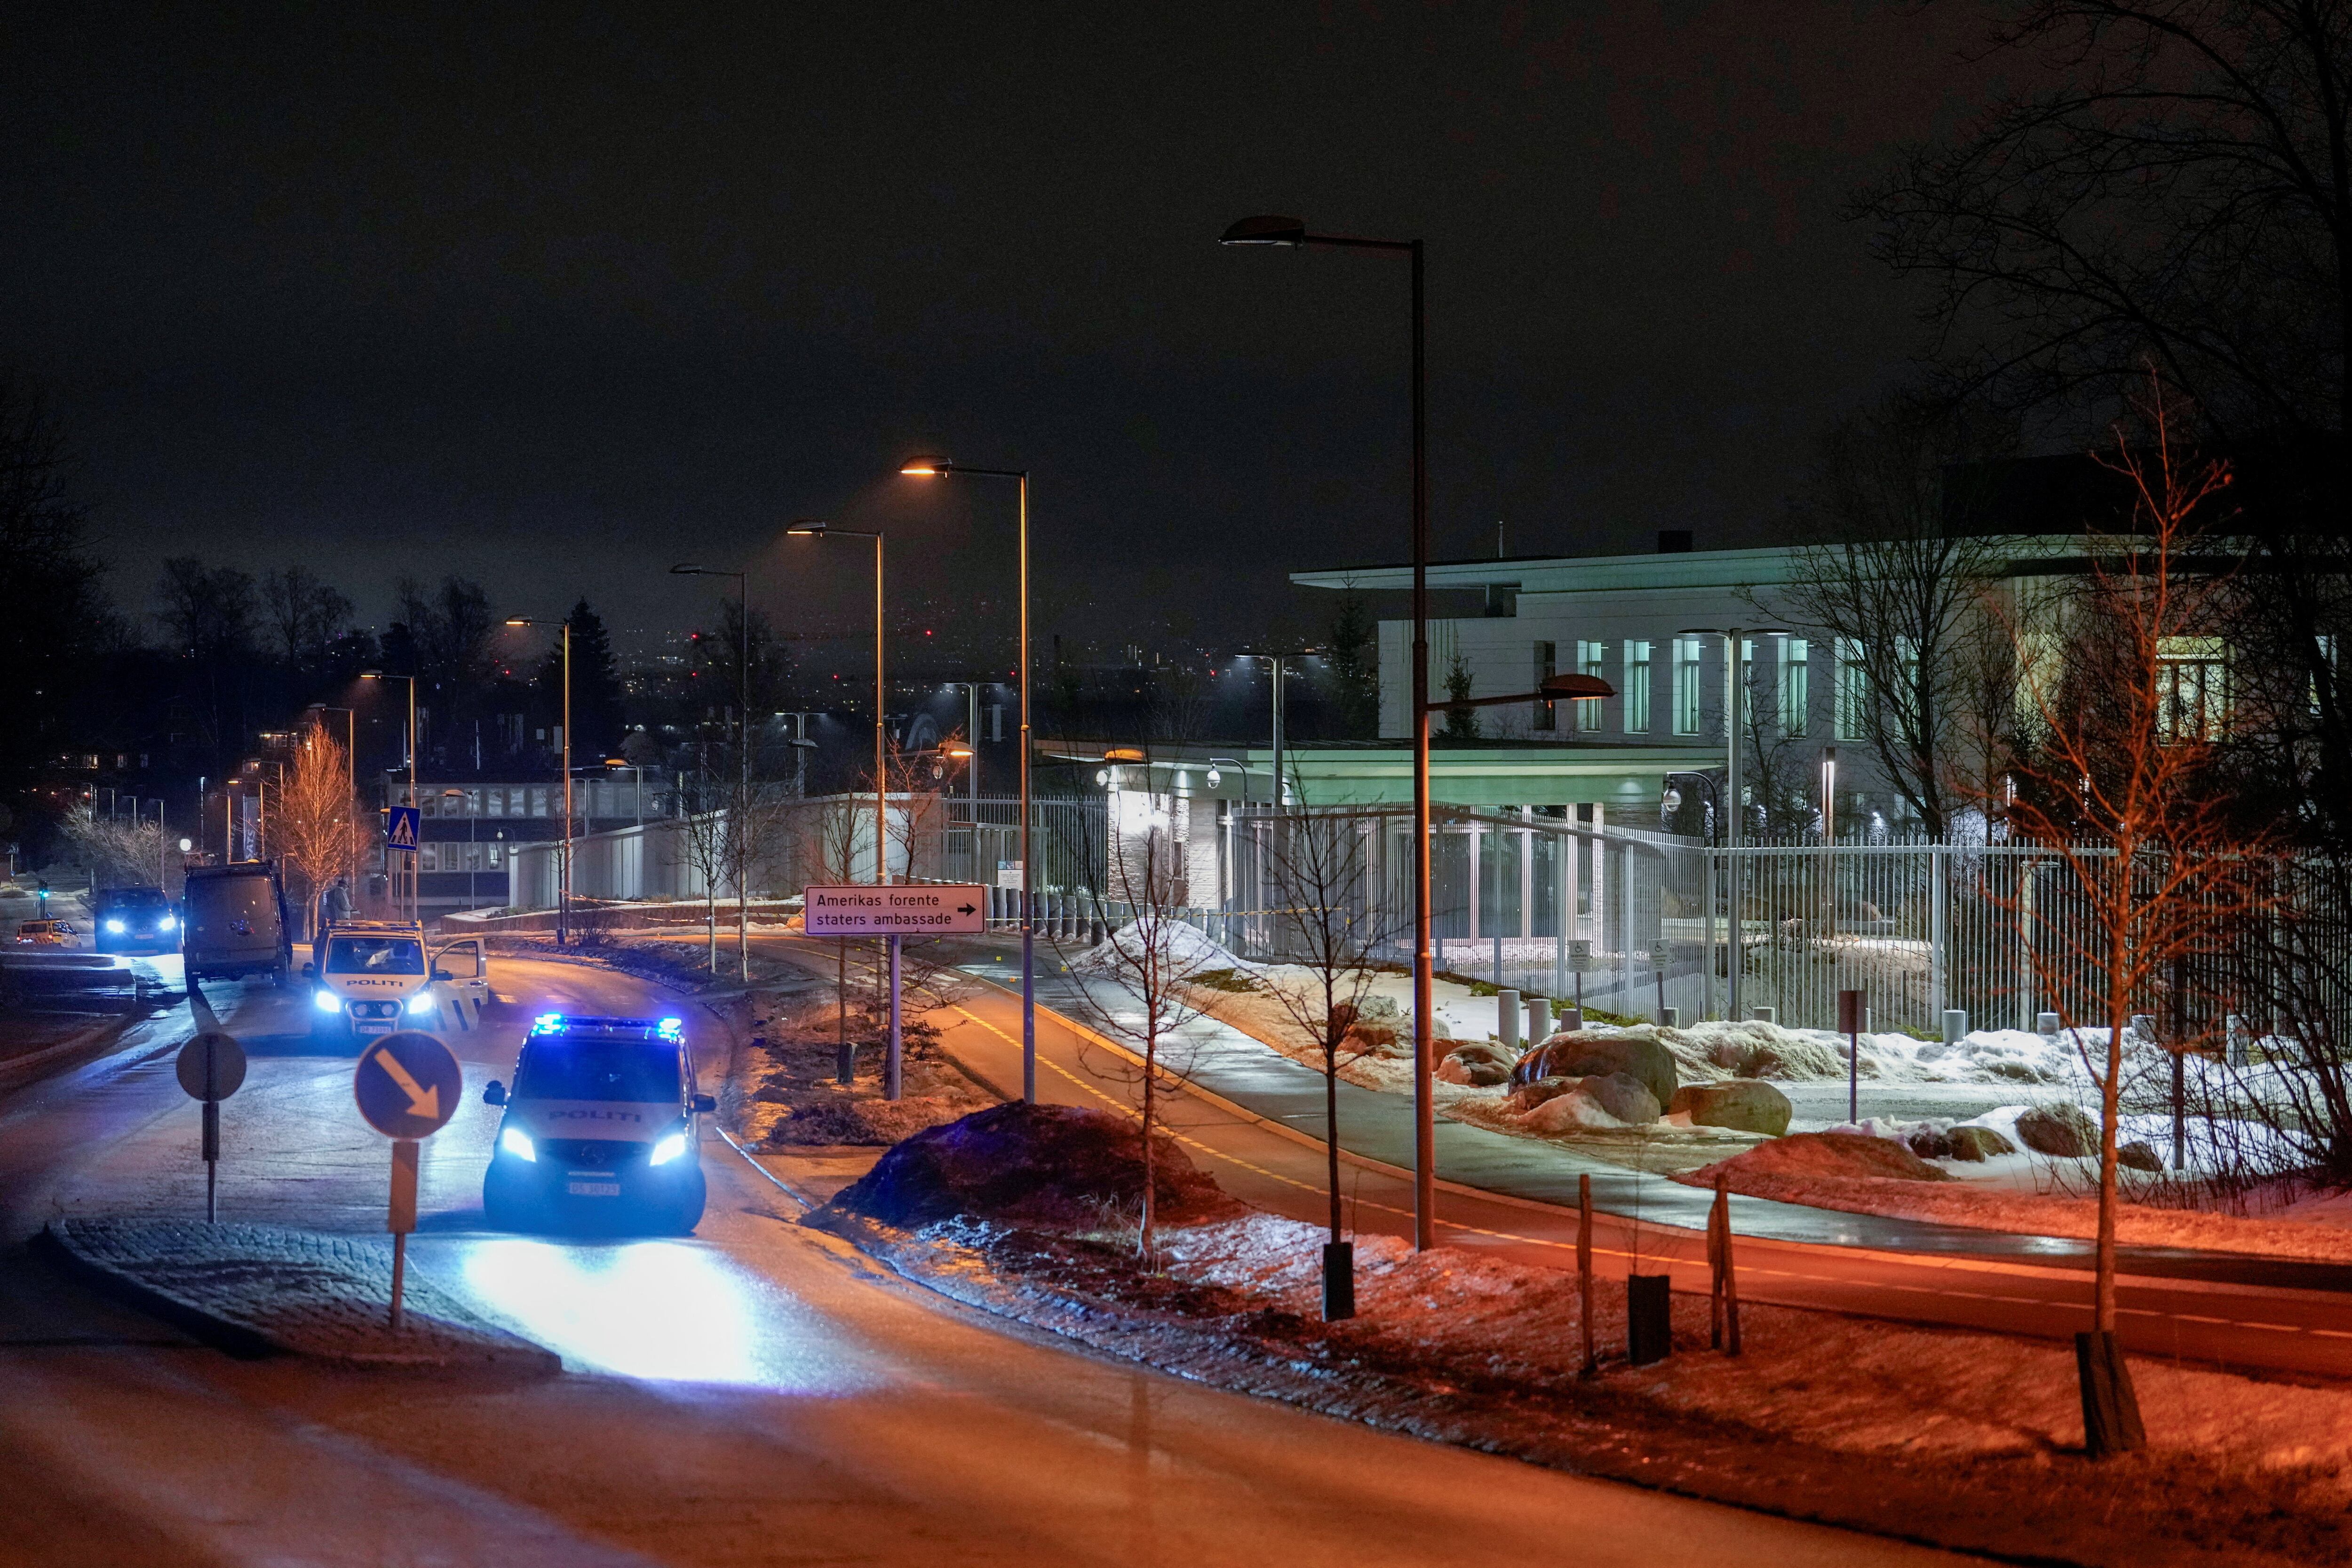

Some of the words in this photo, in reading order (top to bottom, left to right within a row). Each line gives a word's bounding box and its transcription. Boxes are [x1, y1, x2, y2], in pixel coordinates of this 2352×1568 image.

[817, 894, 882, 906] Amerikas
[889, 894, 939, 906] forente
[817, 914, 866, 925] staters
[874, 913, 952, 924] ambassade
[549, 1110, 641, 1122] POLITI
